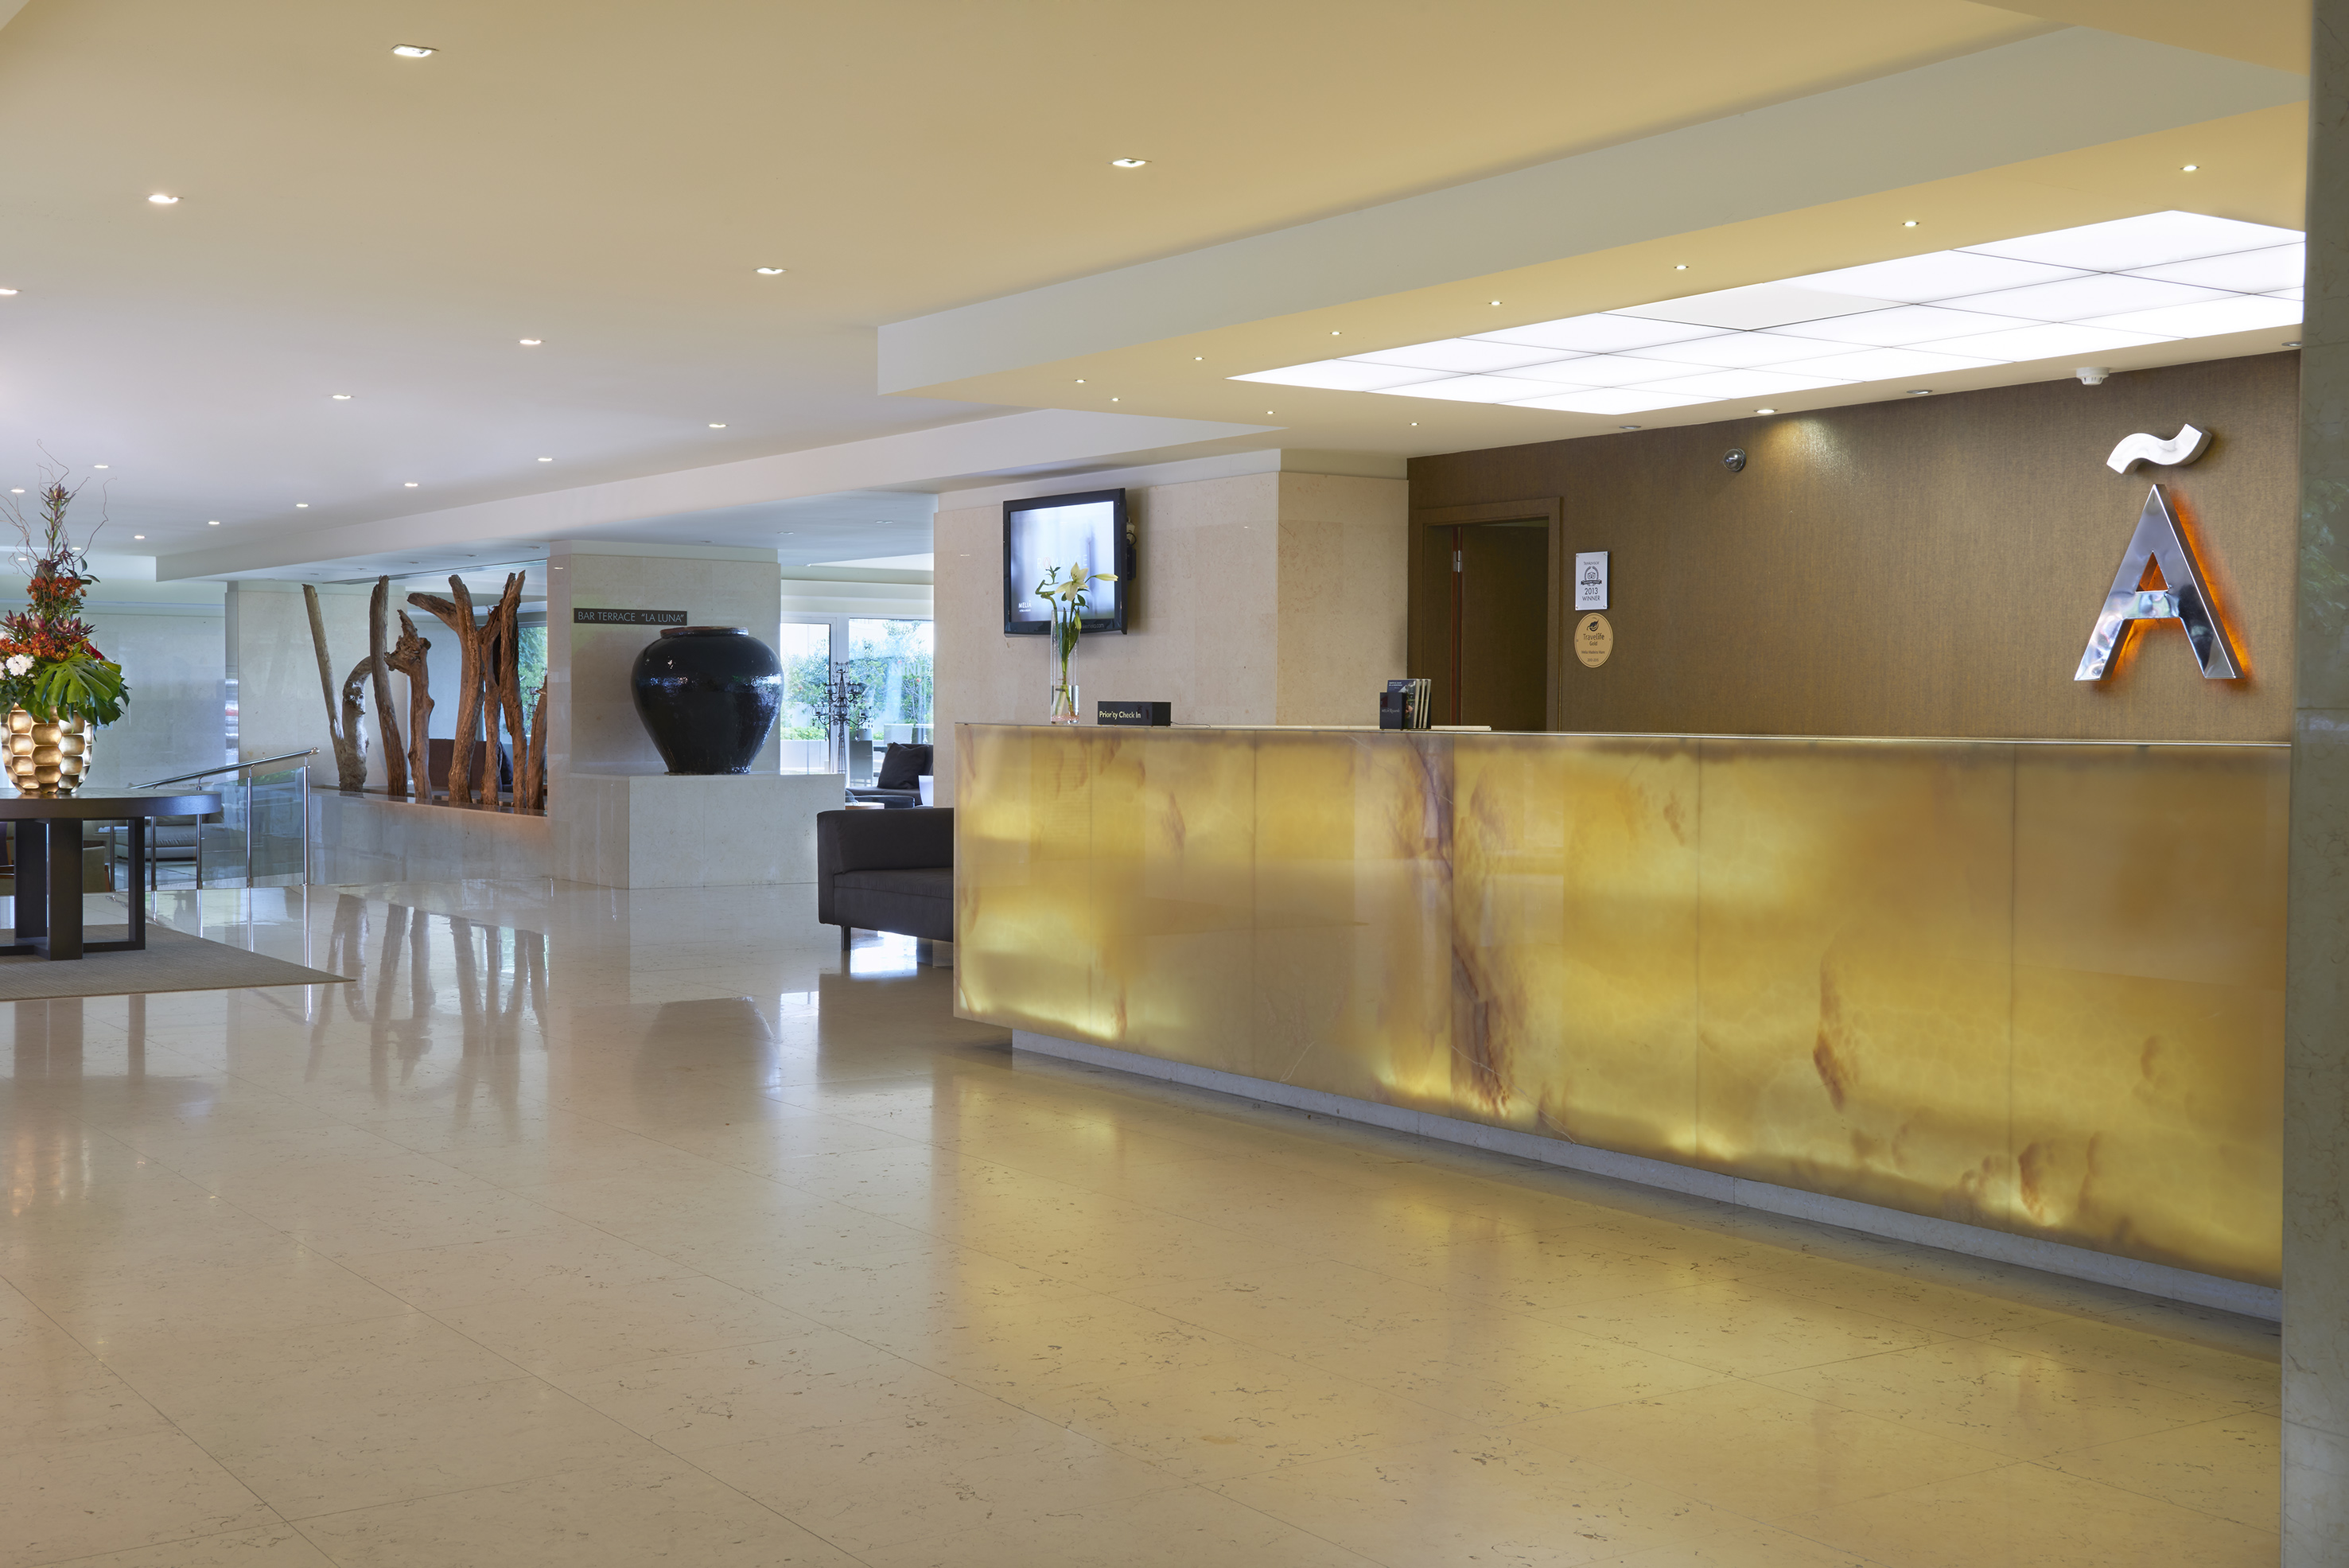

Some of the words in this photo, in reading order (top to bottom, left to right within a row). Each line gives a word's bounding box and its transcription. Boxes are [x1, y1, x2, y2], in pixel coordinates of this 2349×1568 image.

[2074, 423, 2245, 680] Ã
[578, 611, 595, 621] BAR
[597, 612, 636, 621] TERRACE
[1099, 710, 1118, 720] Priority
